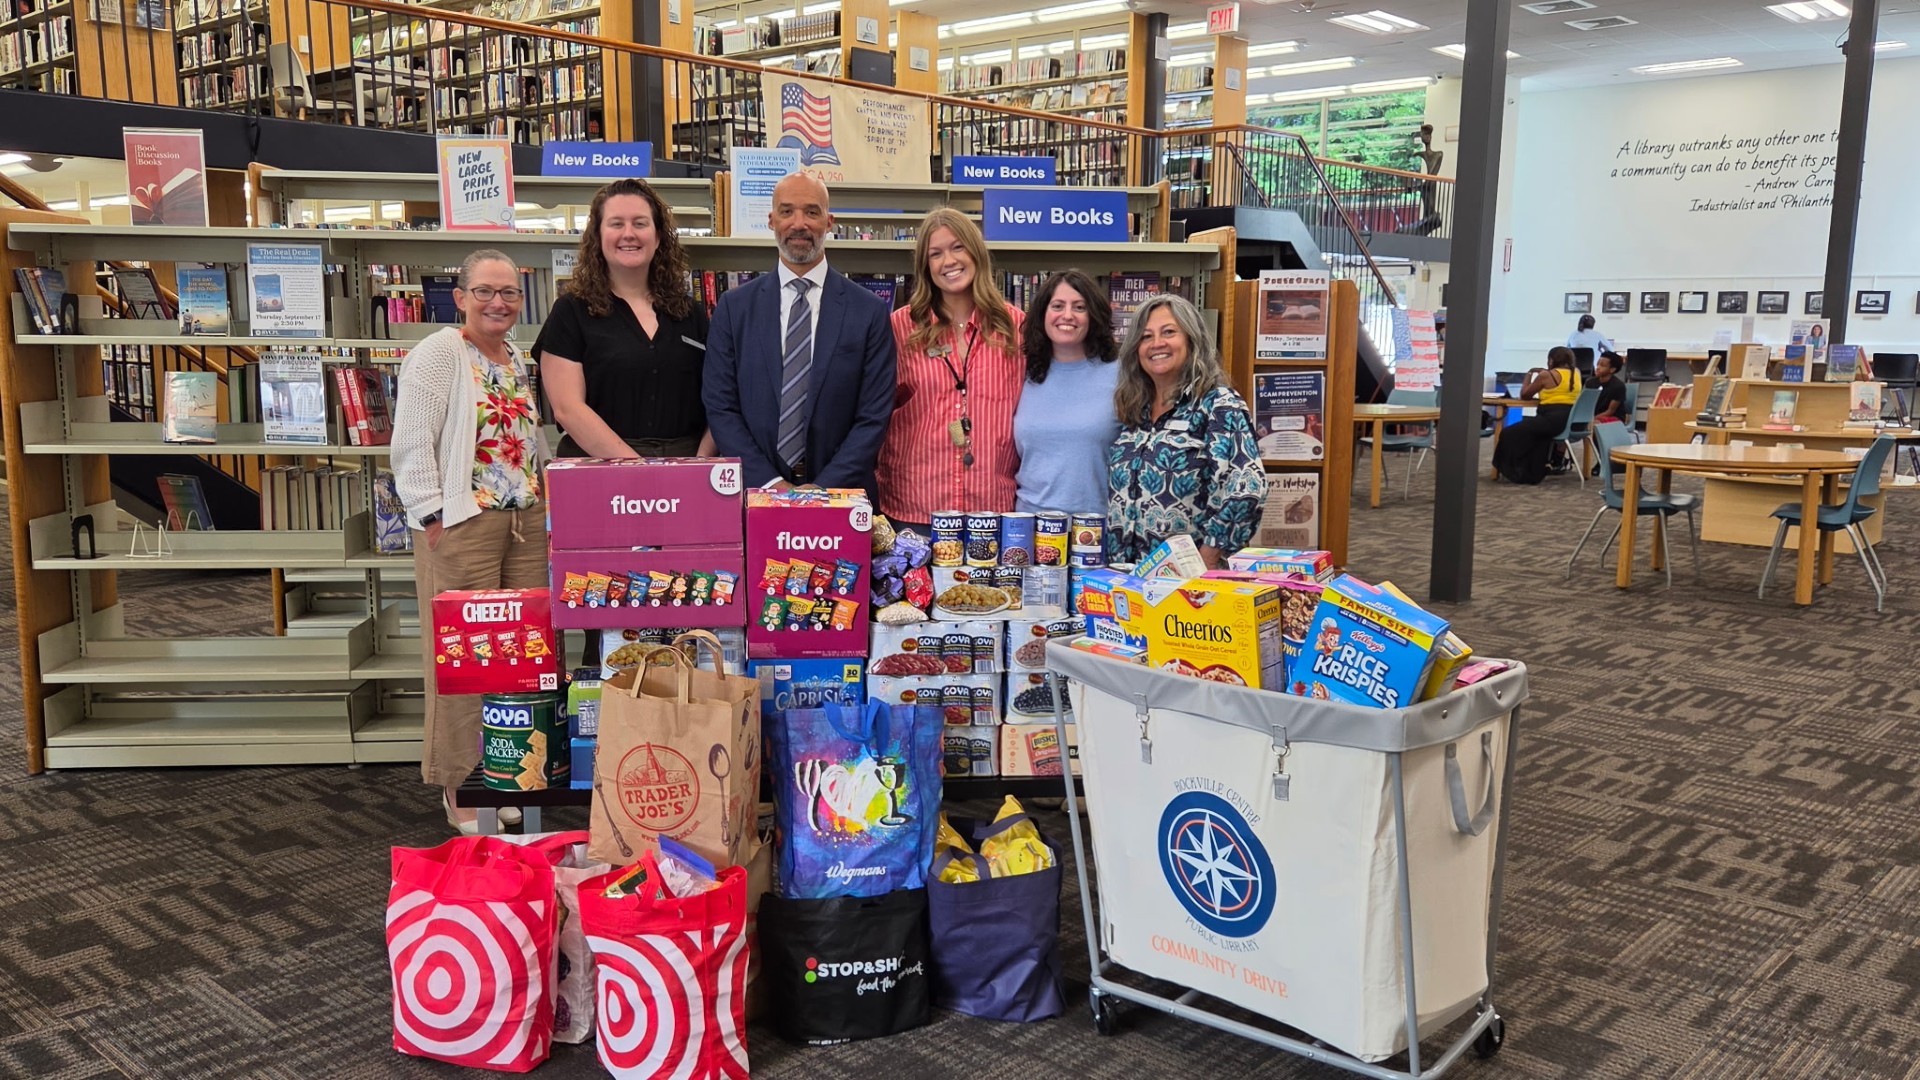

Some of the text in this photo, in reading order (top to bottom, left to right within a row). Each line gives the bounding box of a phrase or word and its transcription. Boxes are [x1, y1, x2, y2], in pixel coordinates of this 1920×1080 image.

[1210, 8, 1233, 29] EXIT
[880, 119, 890, 127] ALL
[893, 113, 916, 121] EVENTS
[867, 126, 906, 138] TO BRING THE
[875, 145, 897, 155] TO LIFE
[1616, 129, 1825, 160] A library outranks any other one
[458, 150, 482, 165] NEW
[553, 152, 640, 166] New Books
[458, 161, 492, 178] LARGE
[963, 166, 1045, 179] New Books
[1611, 168, 1618, 178] a
[1621, 162, 1687, 181] community
[1690, 163, 1712, 173] can
[1715, 156, 1731, 172] do
[1735, 158, 1747, 171] to
[1751, 153, 1798, 175] benefit
[1800, 154, 1817, 168] its
[463, 173, 495, 191] PRINT
[1753, 176, 1799, 192] Andrew
[465, 185, 500, 203] TITLES
[1688, 197, 1755, 212] Industrialist
[1757, 196, 1780, 209] and
[999, 206, 1114, 225] New Books
[259, 248, 274, 256] The
[1124, 278, 1145, 290] MEN
[1112, 290, 1130, 302] LIKE
[719, 468, 735, 482] 42
[1283, 476, 1317, 490] Workshop
[610, 495, 680, 514] flavor
[856, 512, 868, 523] 28
[934, 518, 962, 529] GOYA
[967, 518, 997, 529] GOYA
[776, 531, 843, 550] flavor
[1135, 550, 1166, 577] LARGE SIZE
[1255, 562, 1307, 574] LARGE SIZE
[994, 568, 1022, 576] GOYA
[1085, 591, 1107, 602] FREE
[1257, 605, 1278, 619] Cheerios
[1340, 596, 1384, 622] FAMILY
[1386, 619, 1416, 638] SIZE
[1096, 624, 1124, 639] FROSTED
[1164, 613, 1233, 643] Cheerios
[945, 635, 971, 644] GOYA
[1351, 631, 1385, 652] Kellogg's
[1340, 644, 1389, 683] RICE
[541, 677, 555, 685] 20
[1313, 654, 1399, 709] KRISPIES
[944, 686, 969, 696] GOYA
[775, 691, 821, 712] CAPRI
[483, 705, 530, 726] GOYA
[490, 737, 515, 749] SODA
[1034, 734, 1057, 746] BUSH'S
[485, 745, 525, 758] CRACKERS
[625, 783, 692, 804] TRADER
[1173, 776, 1261, 827] ROCKVILLE CENTRE
[636, 801, 685, 819] JOE'S
[824, 860, 887, 885] Wegmans
[1185, 916, 1260, 952] PUBLIC LIBRARY
[1151, 935, 1289, 999] COMMUNITY DRIVE
[856, 977, 879, 996] feed
[880, 976, 896, 993] the
